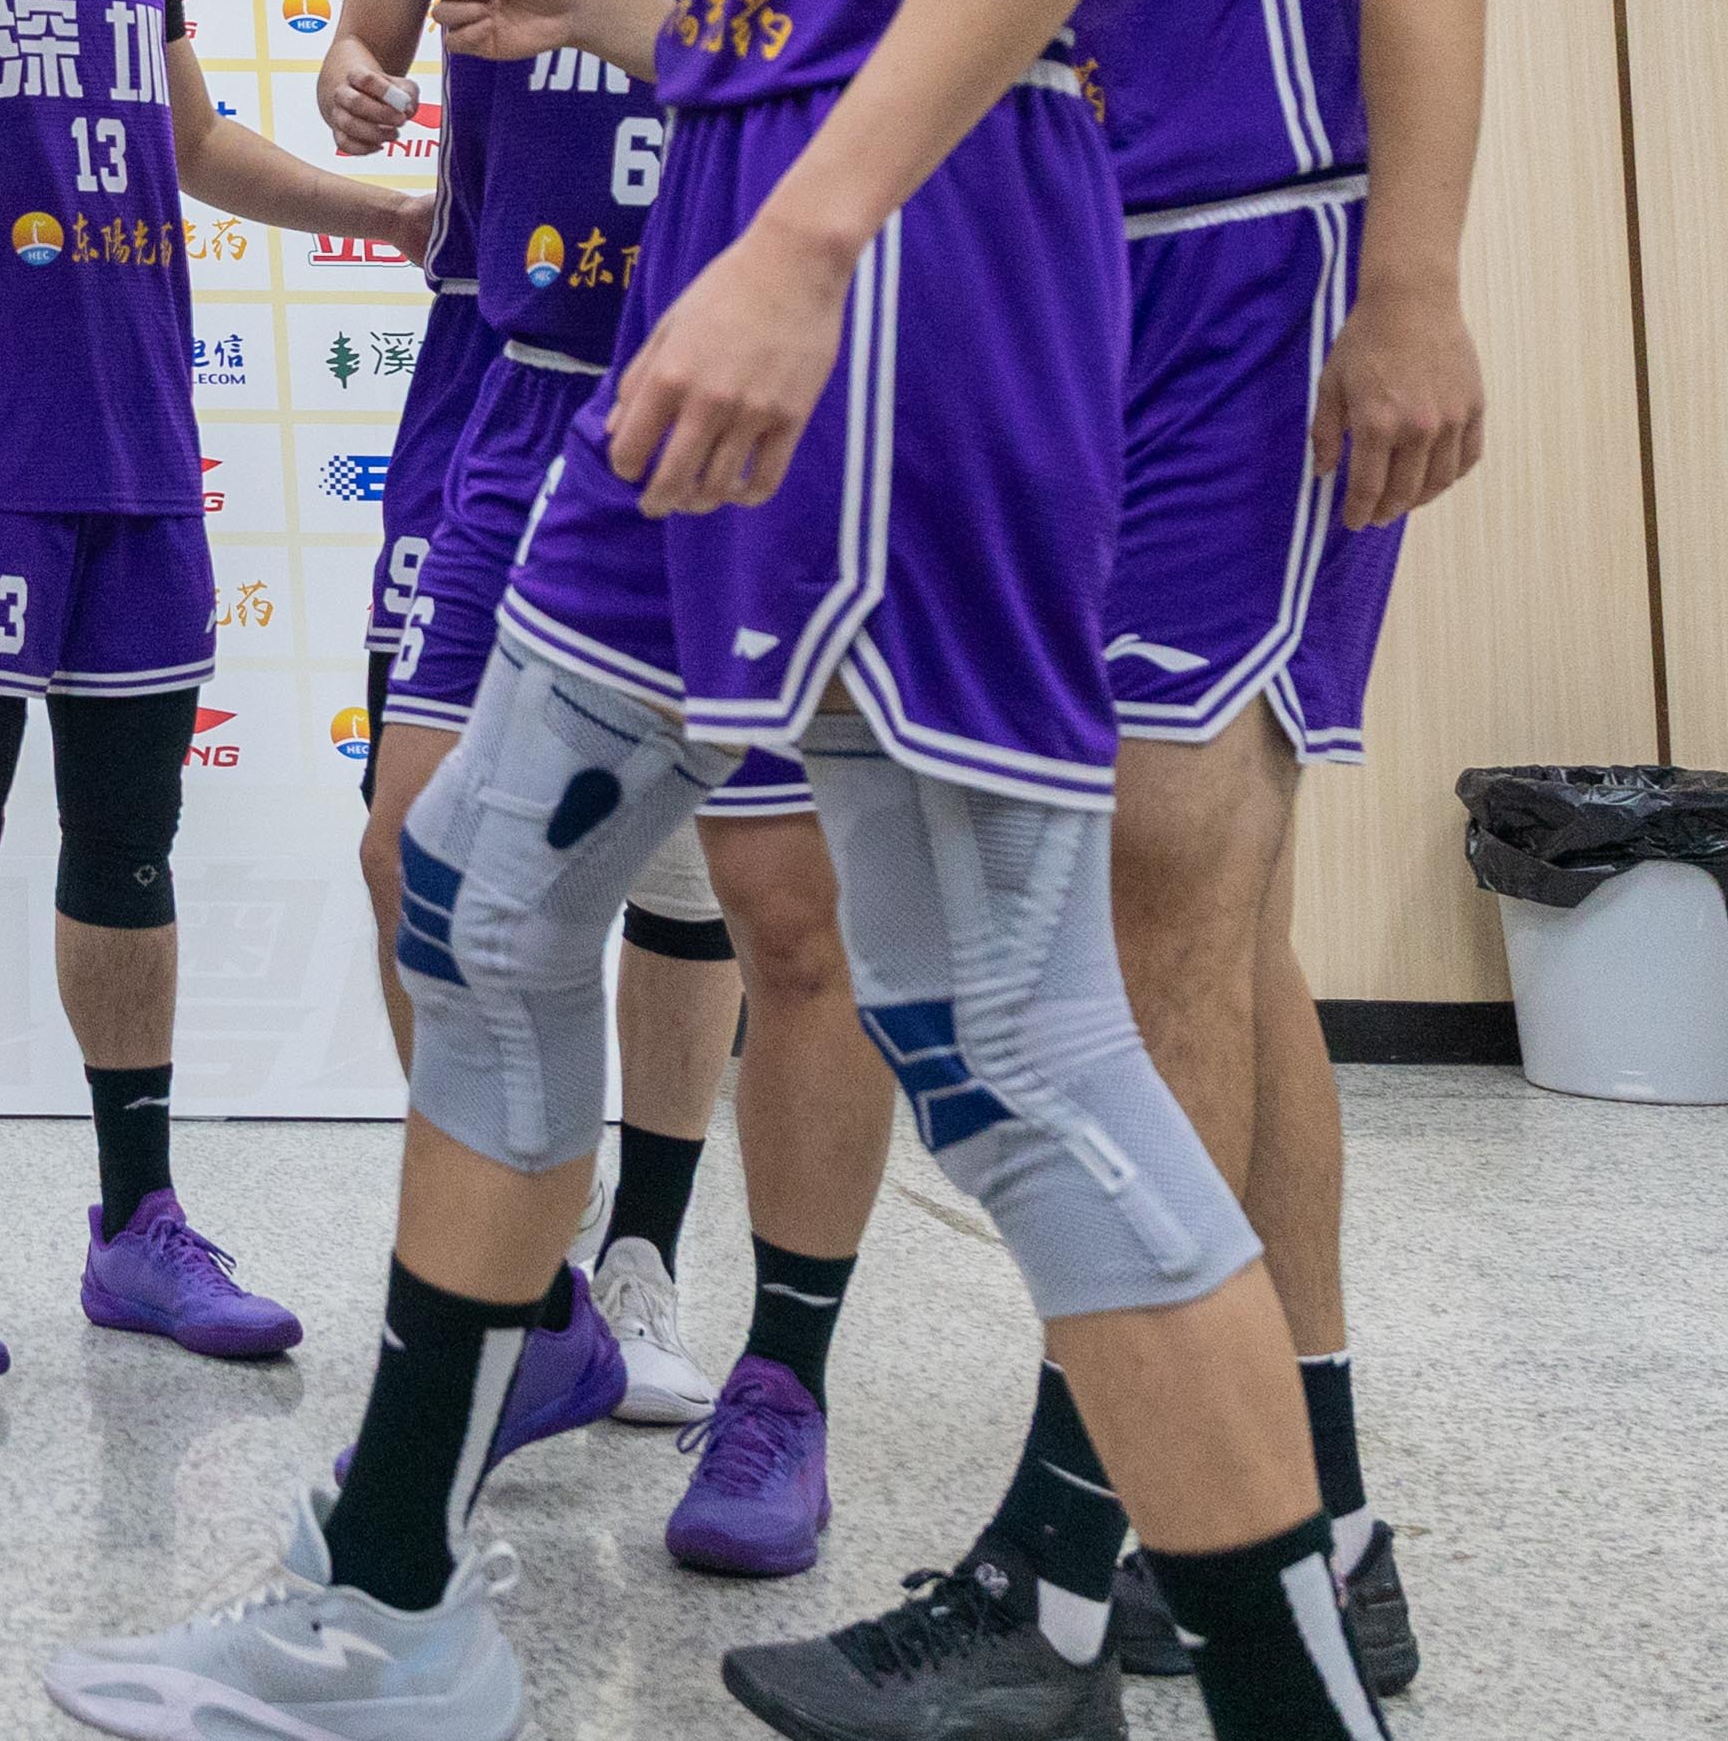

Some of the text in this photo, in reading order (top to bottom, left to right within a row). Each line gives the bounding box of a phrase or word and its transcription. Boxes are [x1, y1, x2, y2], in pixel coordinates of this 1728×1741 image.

[297, 20, 318, 29] HEC
[70, 116, 129, 194] 13
[610, 116, 662, 207] 6
